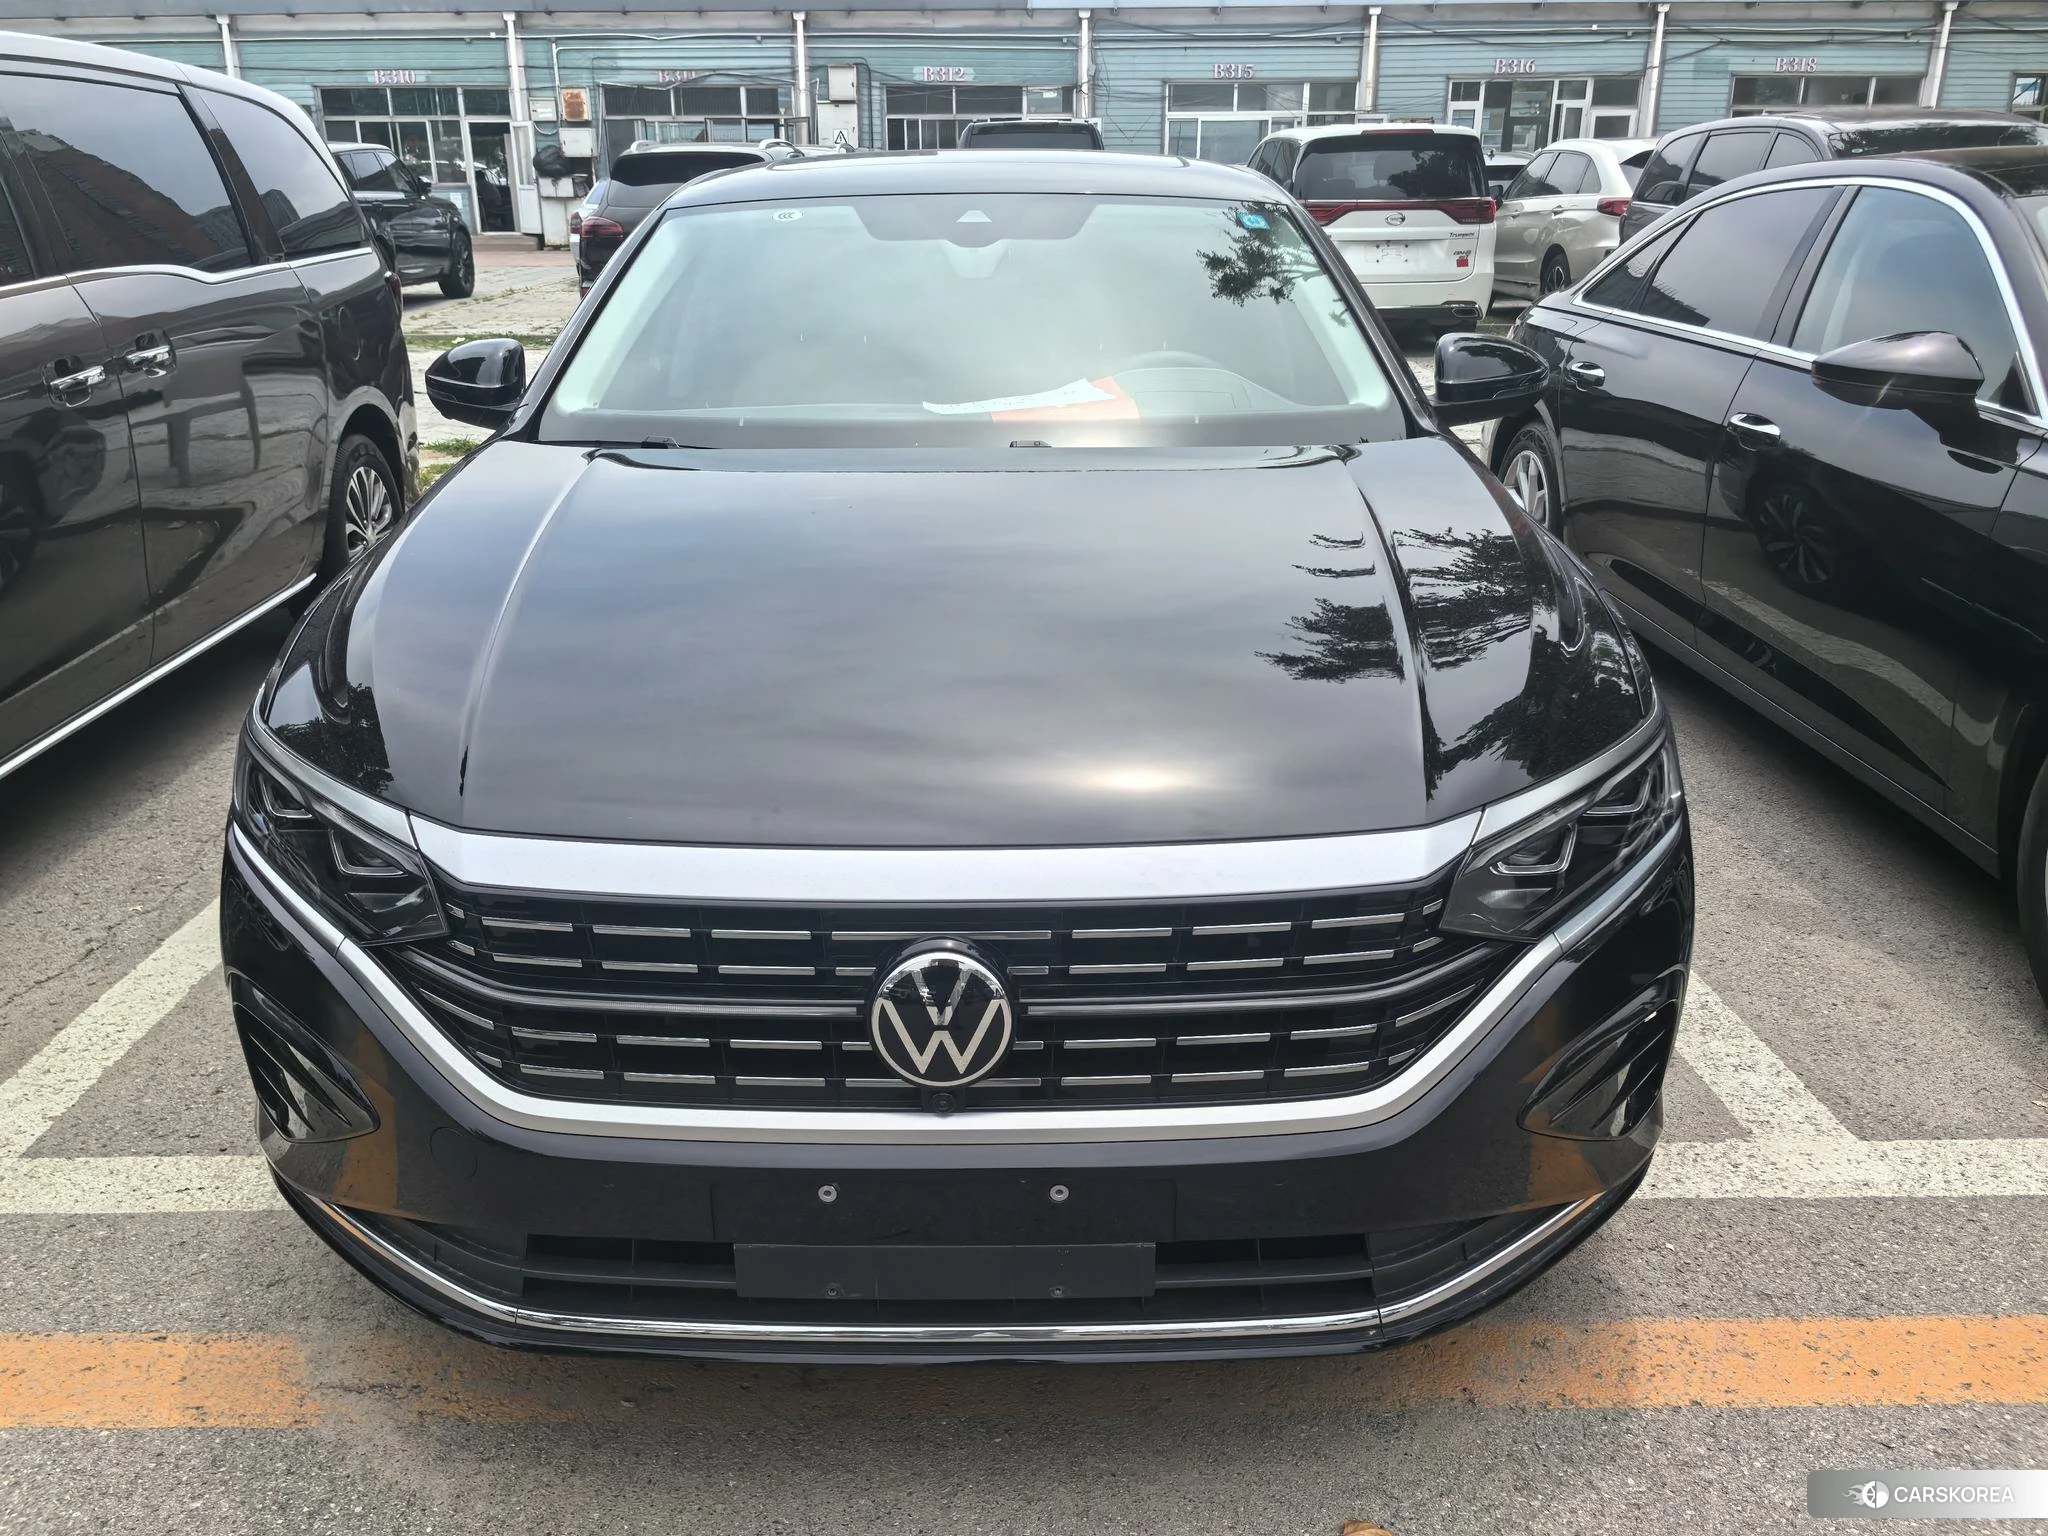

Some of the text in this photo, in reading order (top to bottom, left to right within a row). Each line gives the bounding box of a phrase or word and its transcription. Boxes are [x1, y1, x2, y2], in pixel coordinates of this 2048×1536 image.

[1213, 63, 1254, 79] B315
[1494, 58, 1536, 74] B316
[1775, 56, 1818, 72] B318
[374, 69, 416, 84] B310
[923, 66, 965, 81] B312
